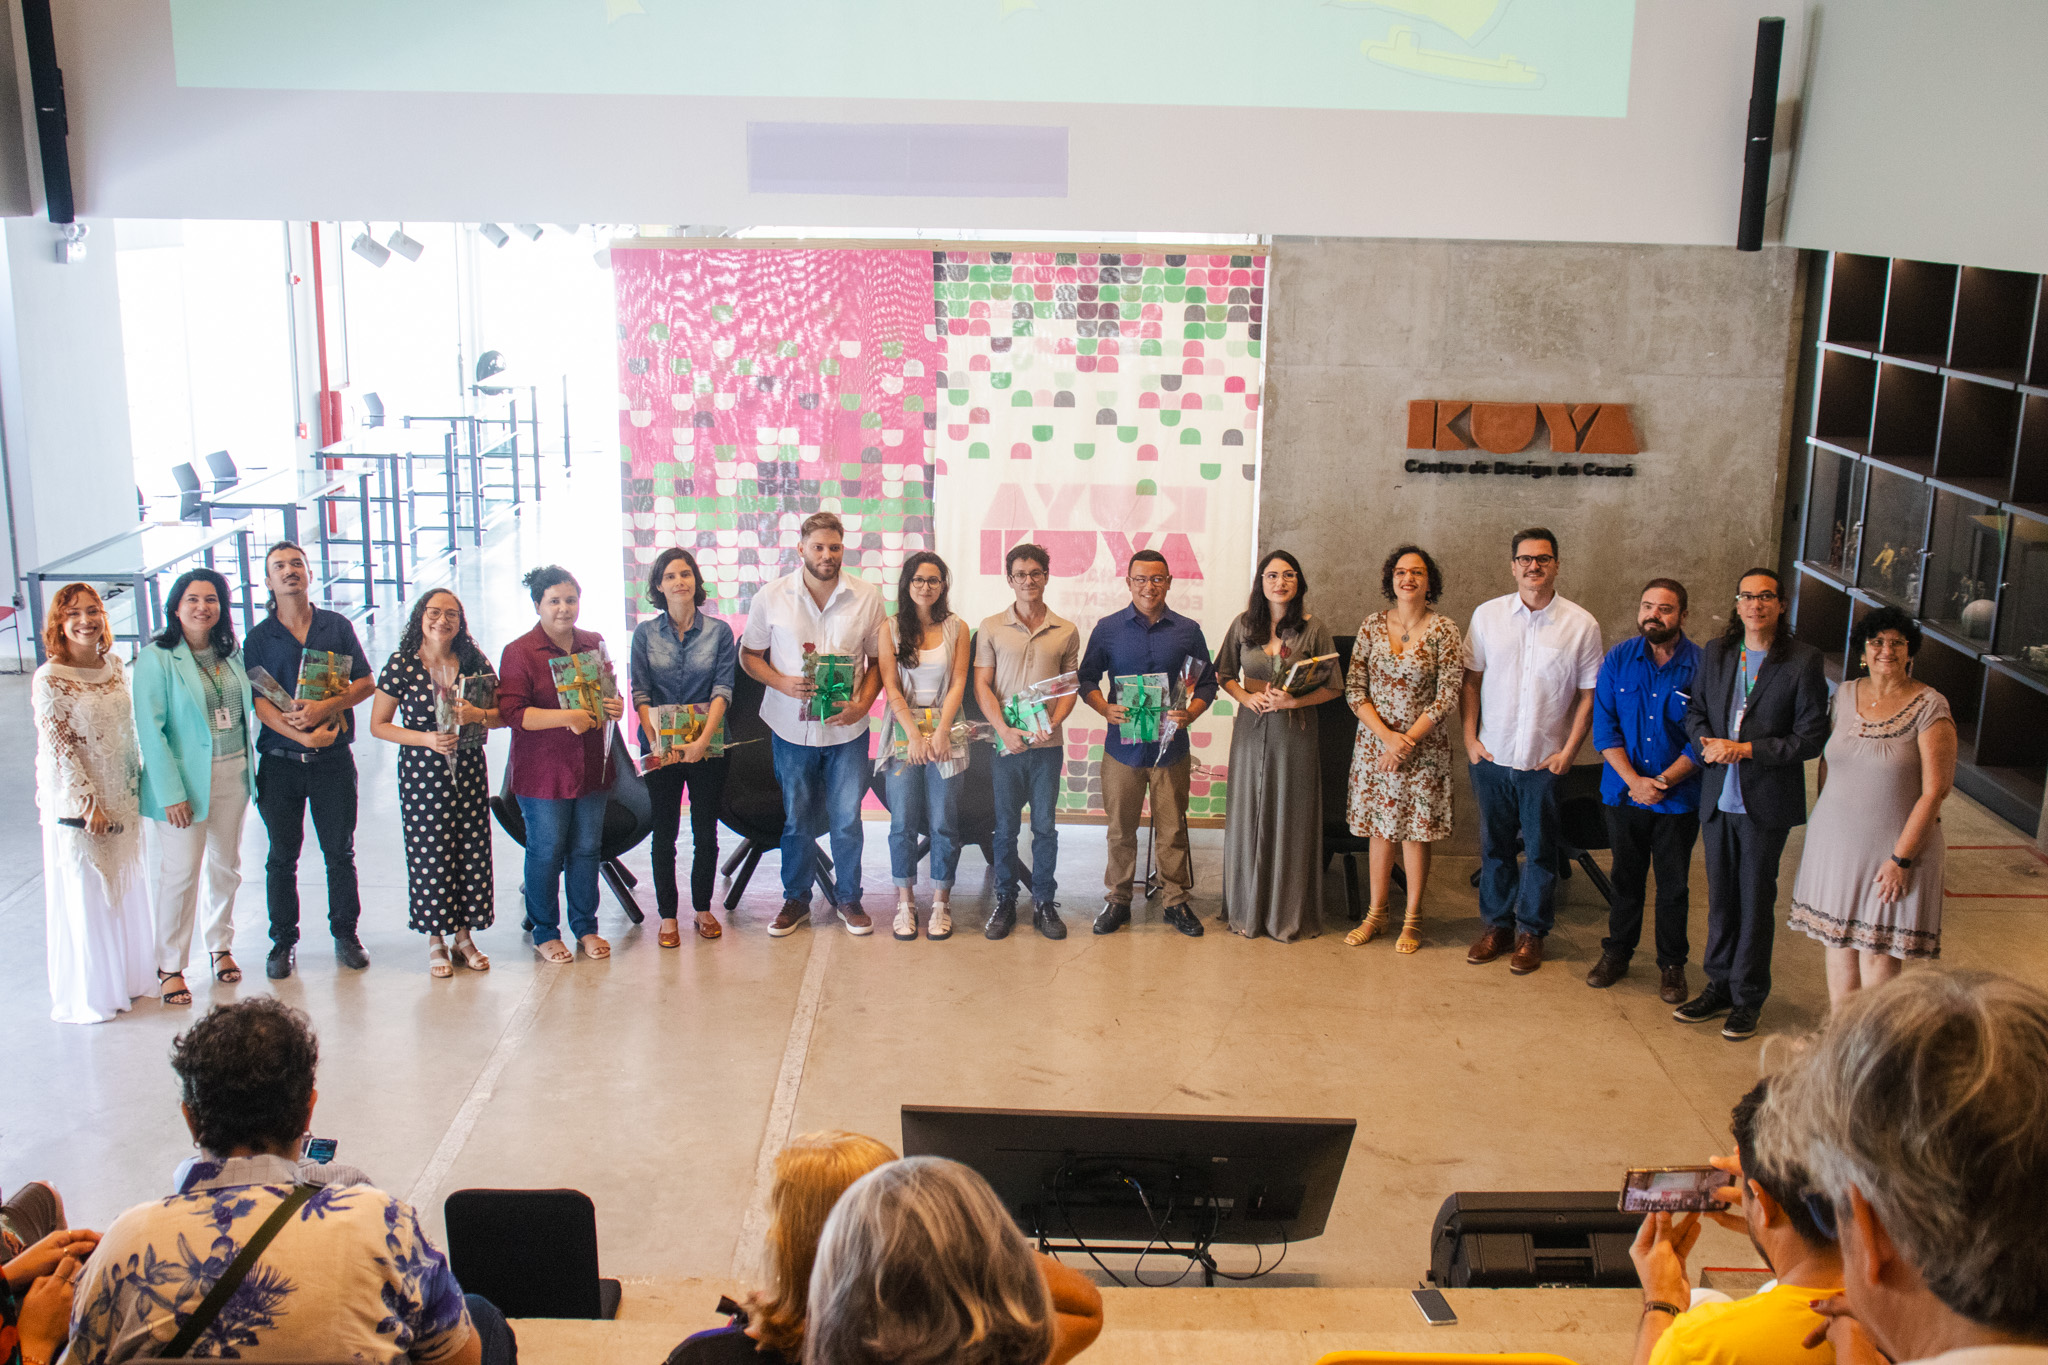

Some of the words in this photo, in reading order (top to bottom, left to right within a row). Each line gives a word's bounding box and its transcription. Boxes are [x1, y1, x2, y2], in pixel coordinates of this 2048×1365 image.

[1407, 400, 1639, 454] KUYA
[1404, 459, 1464, 473] Centro
[1468, 461, 1490, 474] de
[1493, 460, 1552, 479] Design
